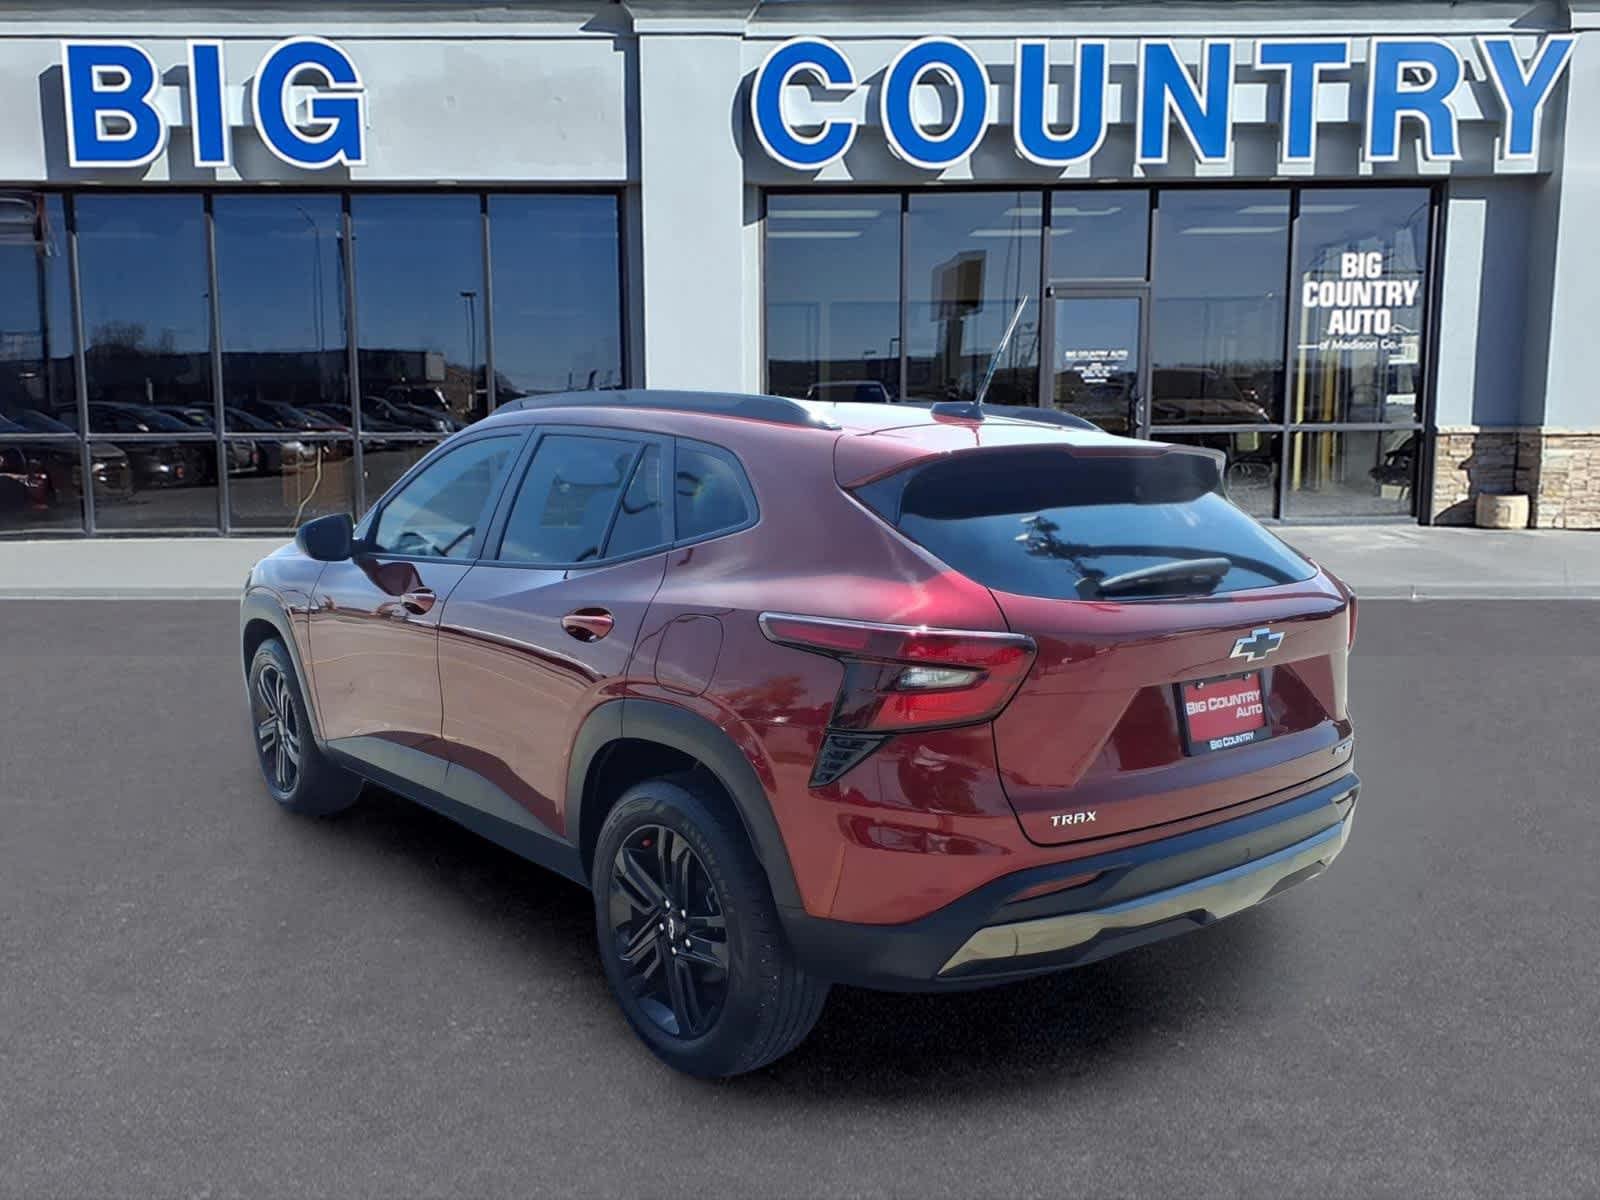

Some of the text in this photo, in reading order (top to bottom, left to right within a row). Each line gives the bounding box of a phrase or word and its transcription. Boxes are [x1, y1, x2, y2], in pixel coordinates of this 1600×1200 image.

[61, 33, 1579, 170] BIG COUNTRY
[1341, 252, 1382, 279] BIG
[1302, 280, 1419, 307] COUNTRY
[1327, 308, 1391, 335] AUTO
[1186, 690, 1260, 716] BIG COUNTRY
[1236, 703, 1263, 718] AUTO
[1223, 731, 1254, 747] COUNTRY
[1050, 810, 1096, 827] TRAX
